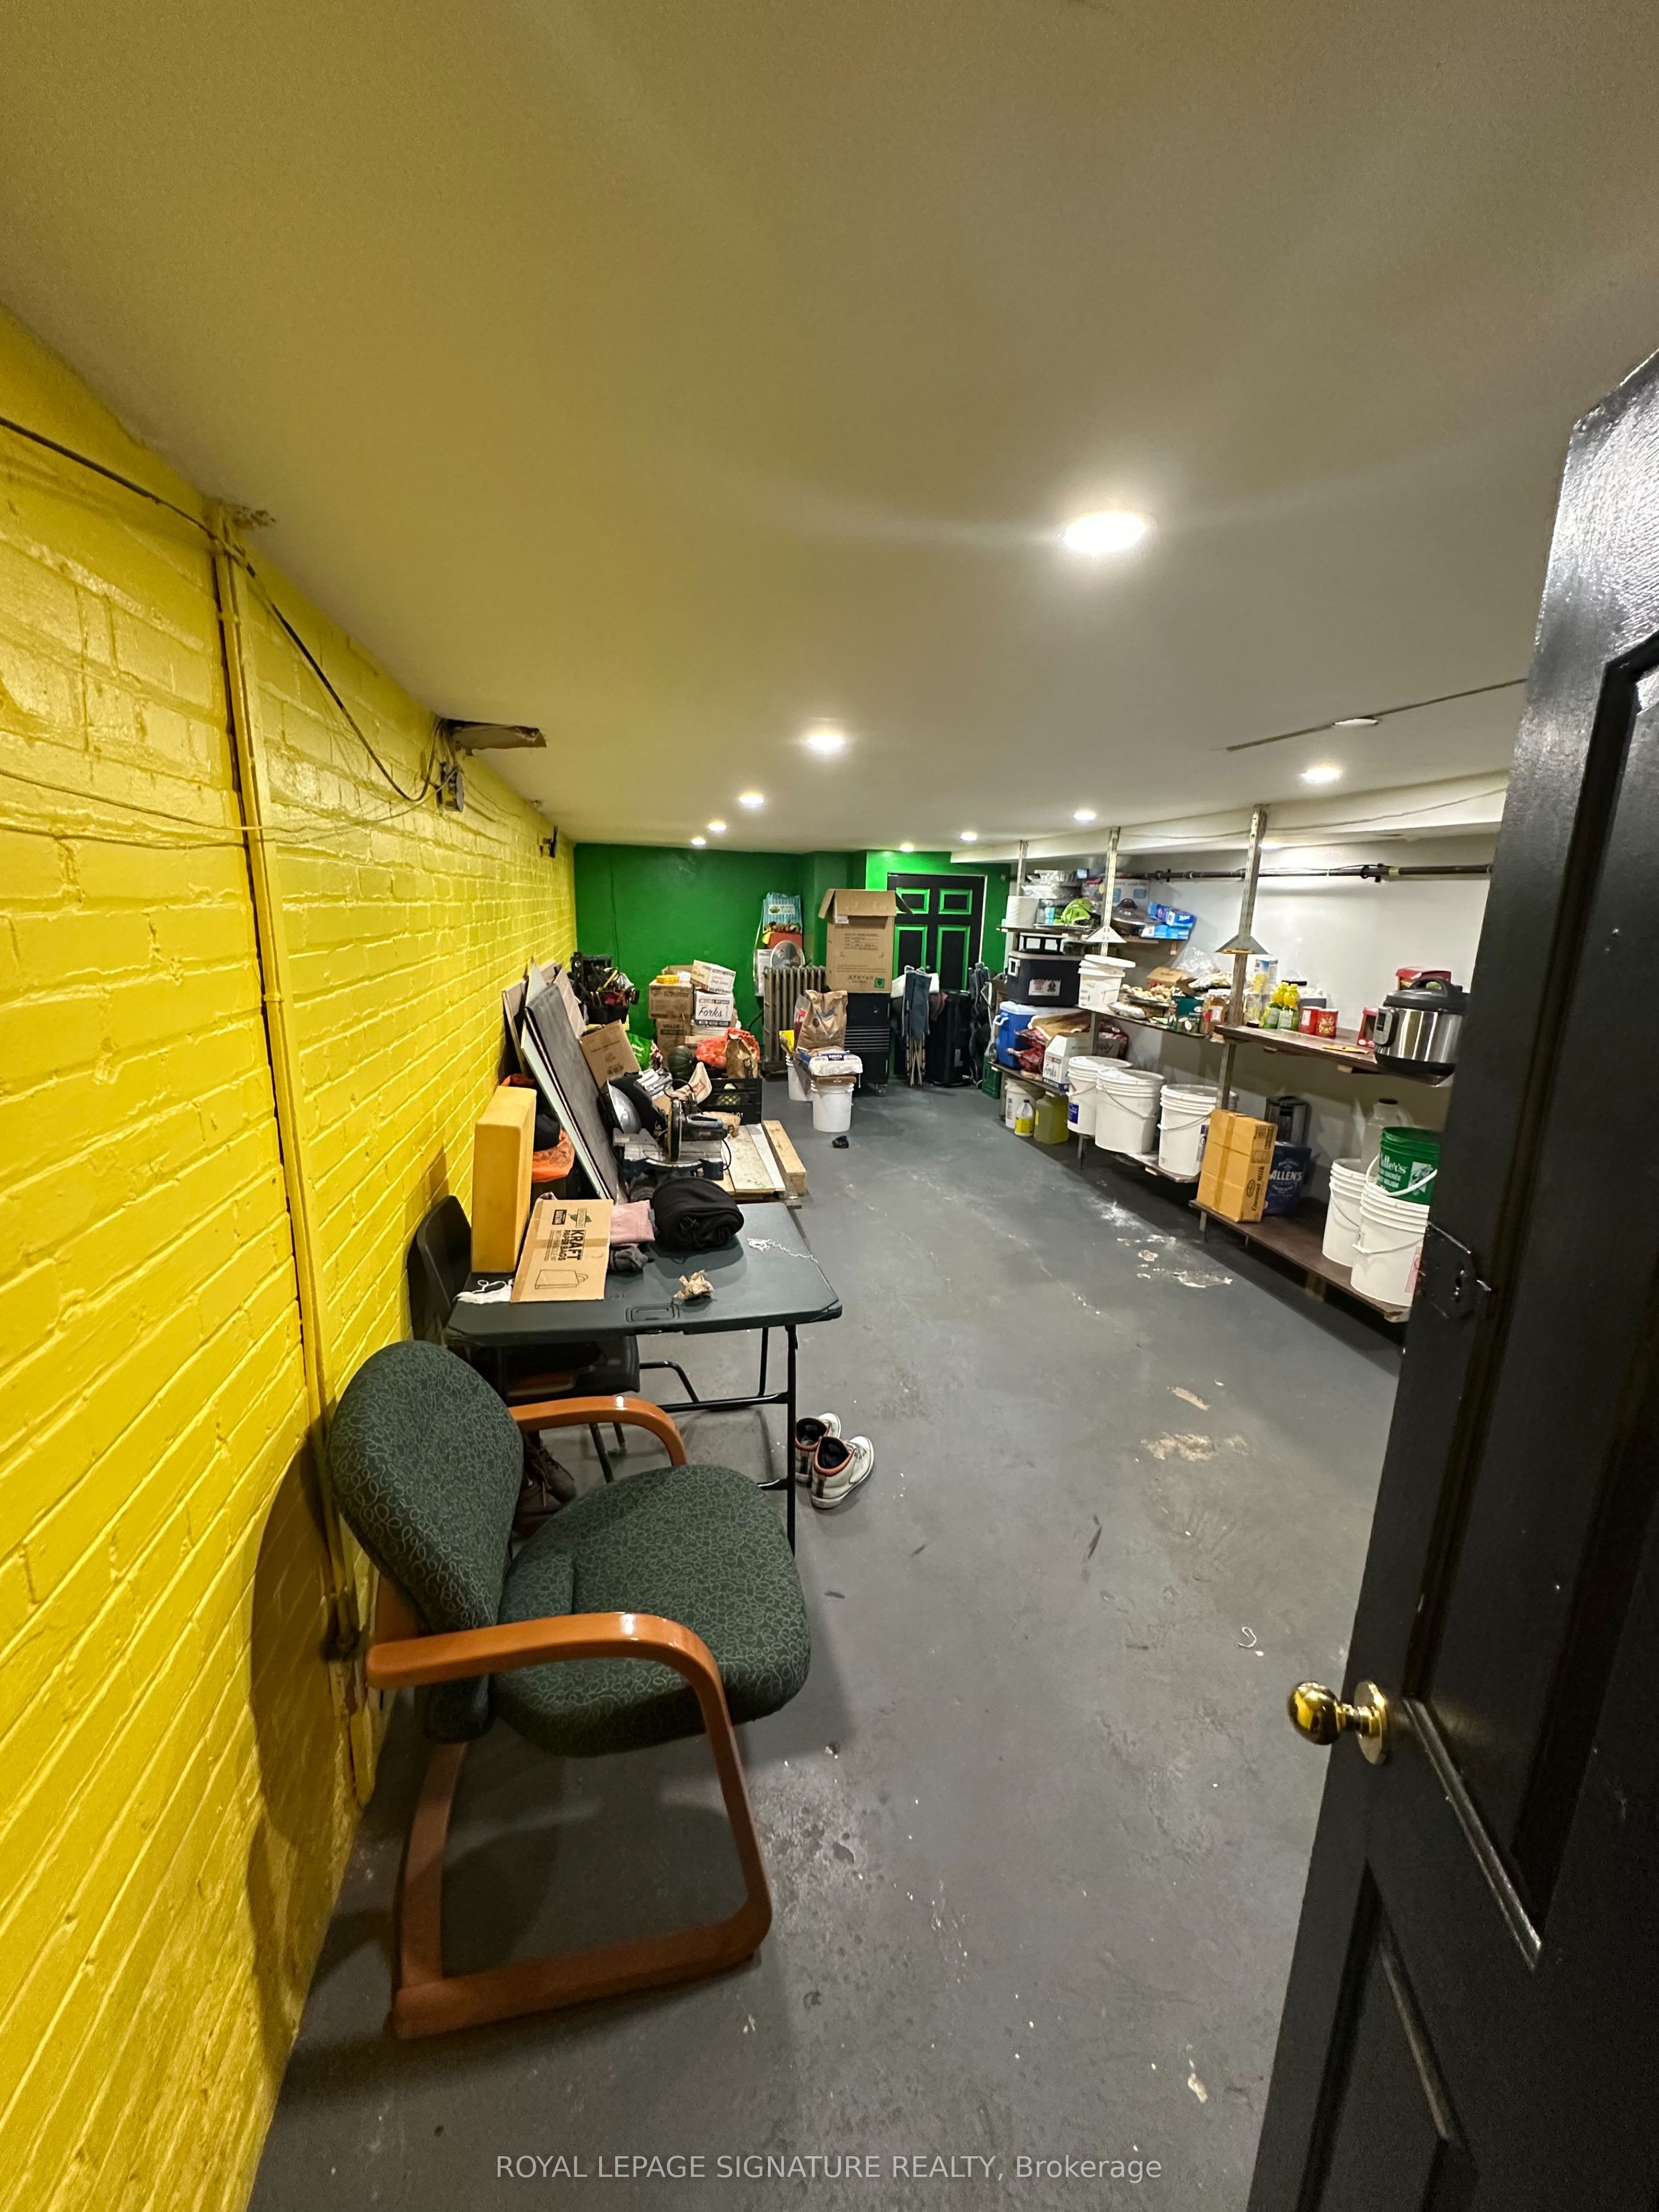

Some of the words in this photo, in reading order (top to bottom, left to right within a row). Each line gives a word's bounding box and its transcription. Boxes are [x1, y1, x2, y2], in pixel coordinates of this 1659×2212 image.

[699, 1006, 723, 1017] Forks
[1270, 1169, 1302, 1181] ALLEN'S
[1251, 1183, 1262, 1211] Coconut
[1257, 1165, 1265, 1182] Milk
[560, 1230, 571, 1246] PAPER
[567, 1229, 585, 1260] KRAFT
[558, 1246, 568, 1261] BAGS
